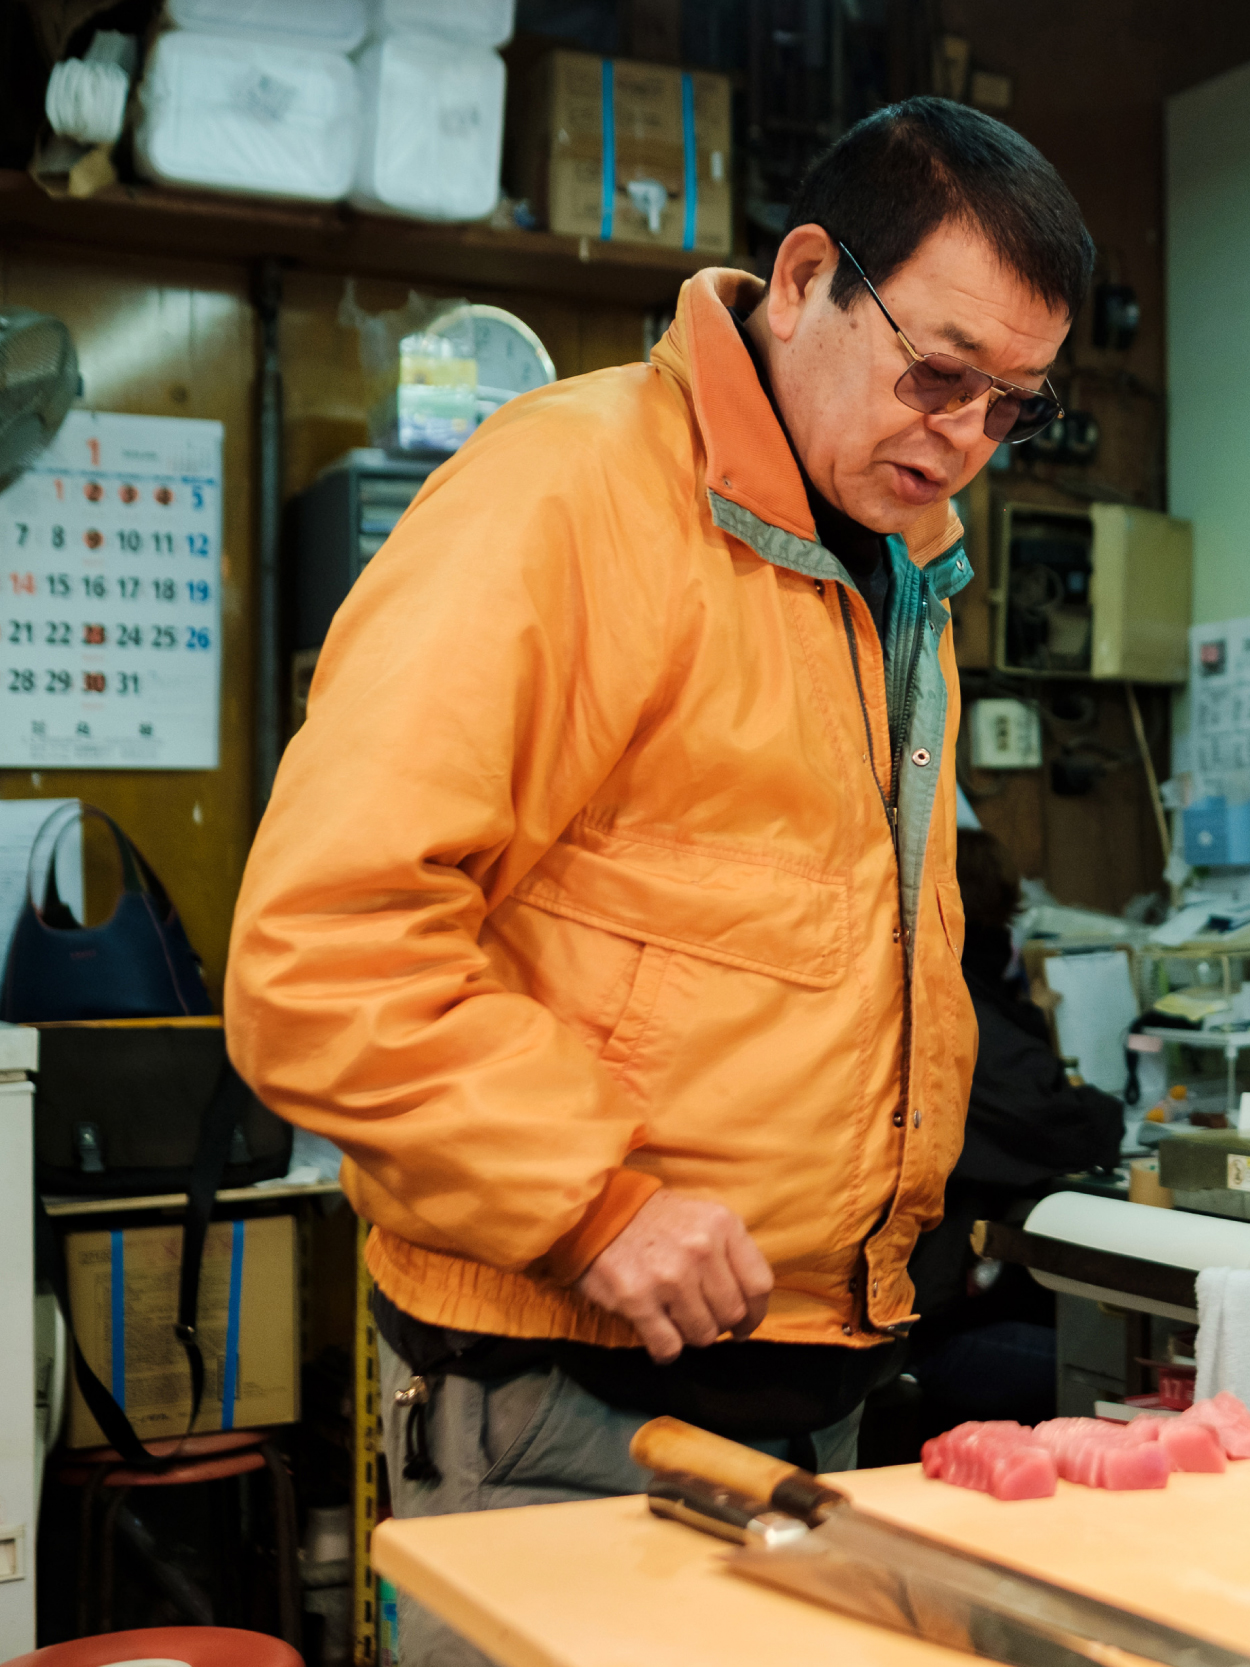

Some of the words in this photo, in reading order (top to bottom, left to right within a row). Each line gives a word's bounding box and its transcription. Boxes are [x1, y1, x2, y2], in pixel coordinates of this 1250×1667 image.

[86, 437, 101, 466] 1
[54, 478, 64, 501] 1
[191, 485, 205, 510] 5
[15, 522, 29, 547] 7
[51, 524, 65, 549] 8
[116, 529, 142, 552] 10
[151, 531, 174, 555] 11
[186, 532, 210, 557] 12
[9, 571, 36, 596] 14
[46, 573, 70, 597] 15
[82, 574, 106, 598] 16
[117, 576, 141, 600] 17
[152, 577, 176, 601] 18
[186, 579, 210, 604] 19
[8, 620, 34, 644] 21
[45, 621, 71, 645] 22
[116, 623, 142, 647] 24
[151, 625, 177, 649] 25
[186, 626, 211, 650] 26
[8, 668, 35, 692] 28
[44, 669, 72, 692] 29
[116, 671, 140, 695] 31
